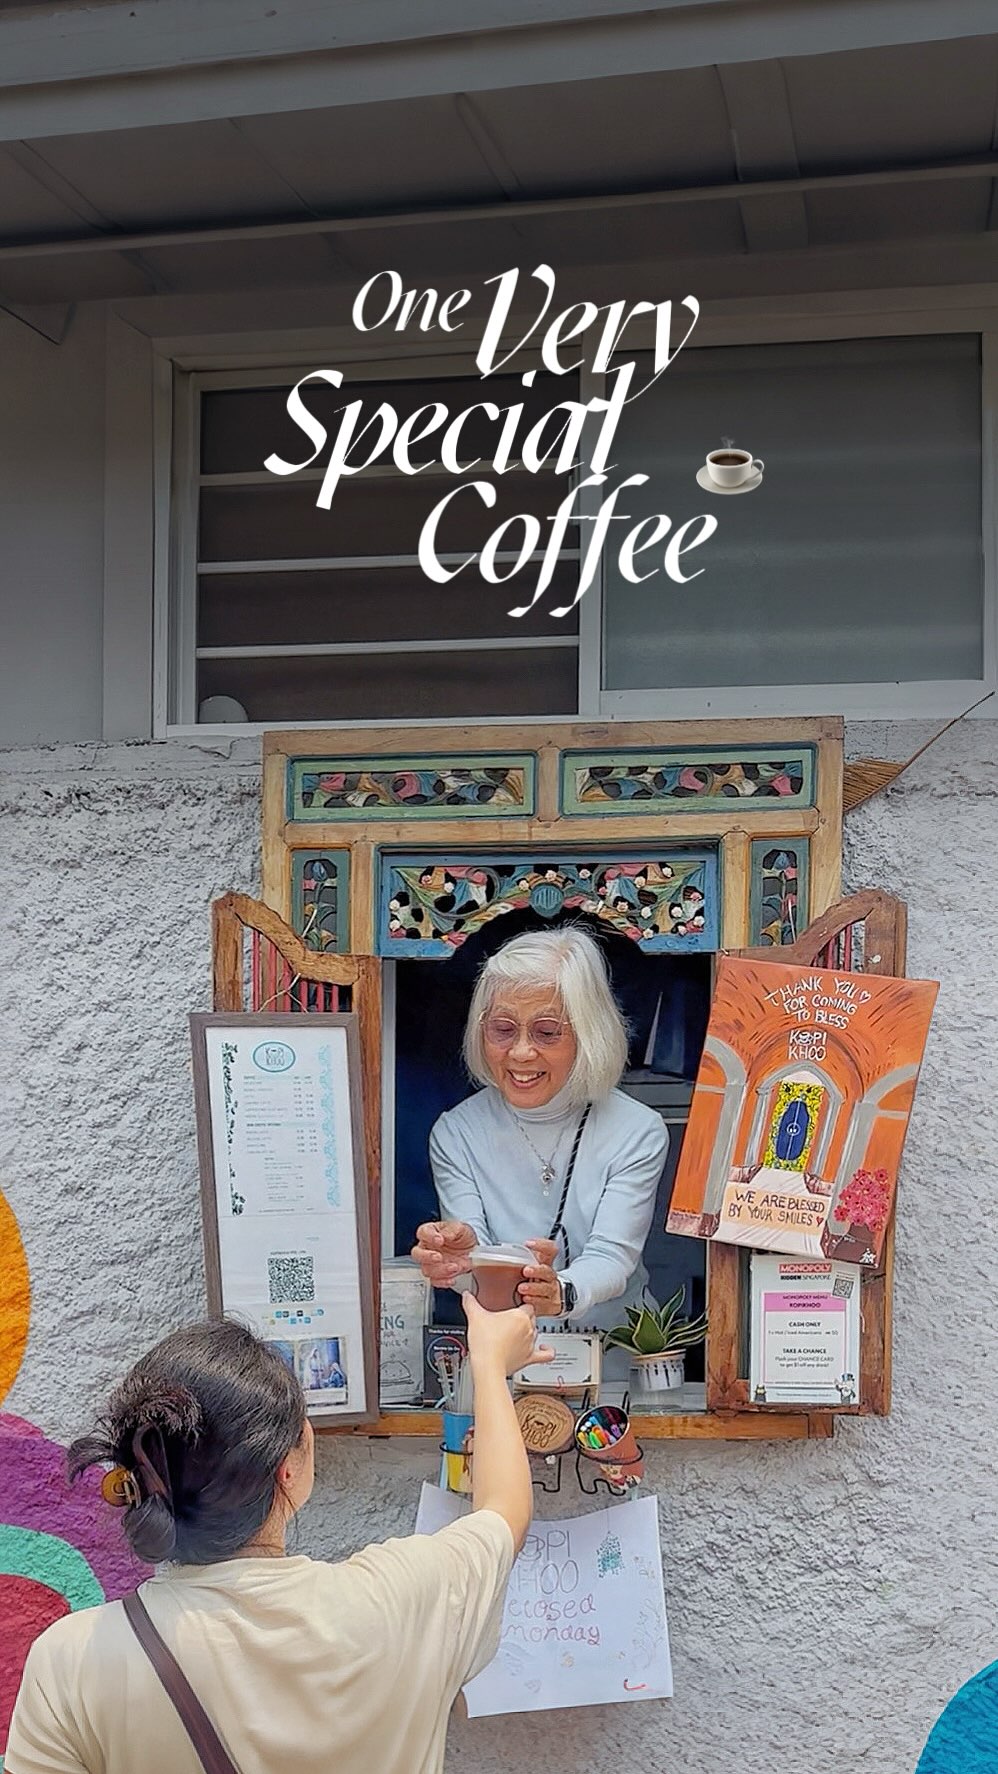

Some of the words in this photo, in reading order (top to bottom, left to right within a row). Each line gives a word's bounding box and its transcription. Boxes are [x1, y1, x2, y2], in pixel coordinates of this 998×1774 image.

[764, 976, 823, 1006] THANK
[834, 977, 859, 999] YOU
[784, 995, 808, 1014] FOR
[812, 994, 857, 1015] COMING
[791, 1008, 810, 1022] TO
[815, 1010, 849, 1029] BLESS
[788, 1045, 826, 1060] KHOO
[735, 1190, 756, 1204] WE
[759, 1194, 786, 1209] ARE
[787, 1198, 825, 1213] BLESSED
[728, 1203, 741, 1218] BY
[748, 1206, 773, 1222] YOUR
[779, 1212, 813, 1225] SMILES
[780, 1263, 832, 1272] MONOPOLY
[508, 1560, 579, 1594] HOO
[508, 1594, 597, 1621] closed
[501, 1624, 600, 1646] monday
